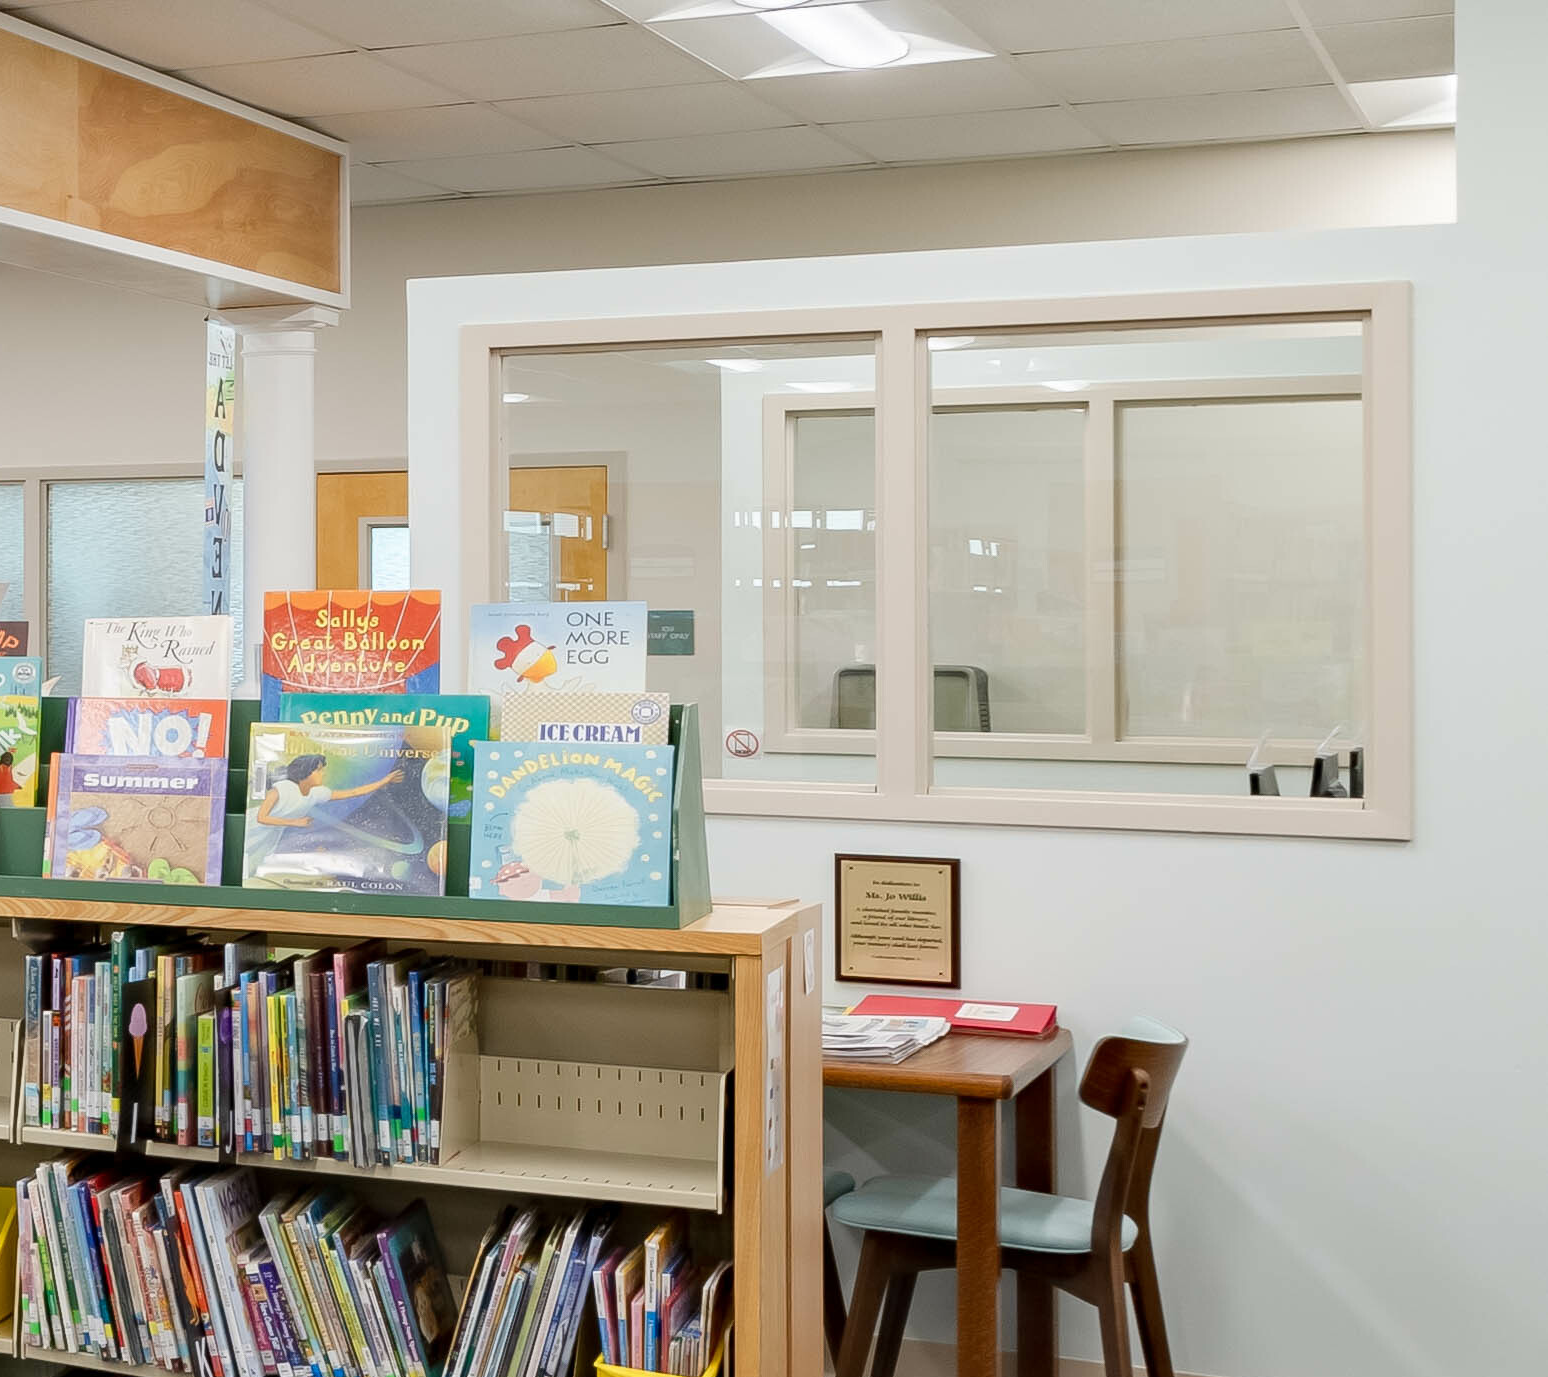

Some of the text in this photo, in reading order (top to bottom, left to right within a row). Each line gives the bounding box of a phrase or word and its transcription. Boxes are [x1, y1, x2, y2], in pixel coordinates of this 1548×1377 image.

[315, 609, 379, 633] Sally's
[566, 611, 614, 627] ONE
[105, 622, 125, 634] The
[126, 622, 160, 649] King
[271, 631, 425, 652] Great Balloon
[565, 630, 630, 646] MORE
[160, 639, 216, 664] Rained
[566, 650, 610, 665] EGG
[287, 658, 407, 674] Adventure
[300, 709, 377, 728] Penny
[381, 711, 416, 725] and
[419, 708, 470, 739] Pup
[539, 724, 641, 743] ICE CREAM
[108, 712, 213, 758] NO!
[83, 774, 199, 790] Summer
[489, 750, 664, 803] DANDELION MAGIC
